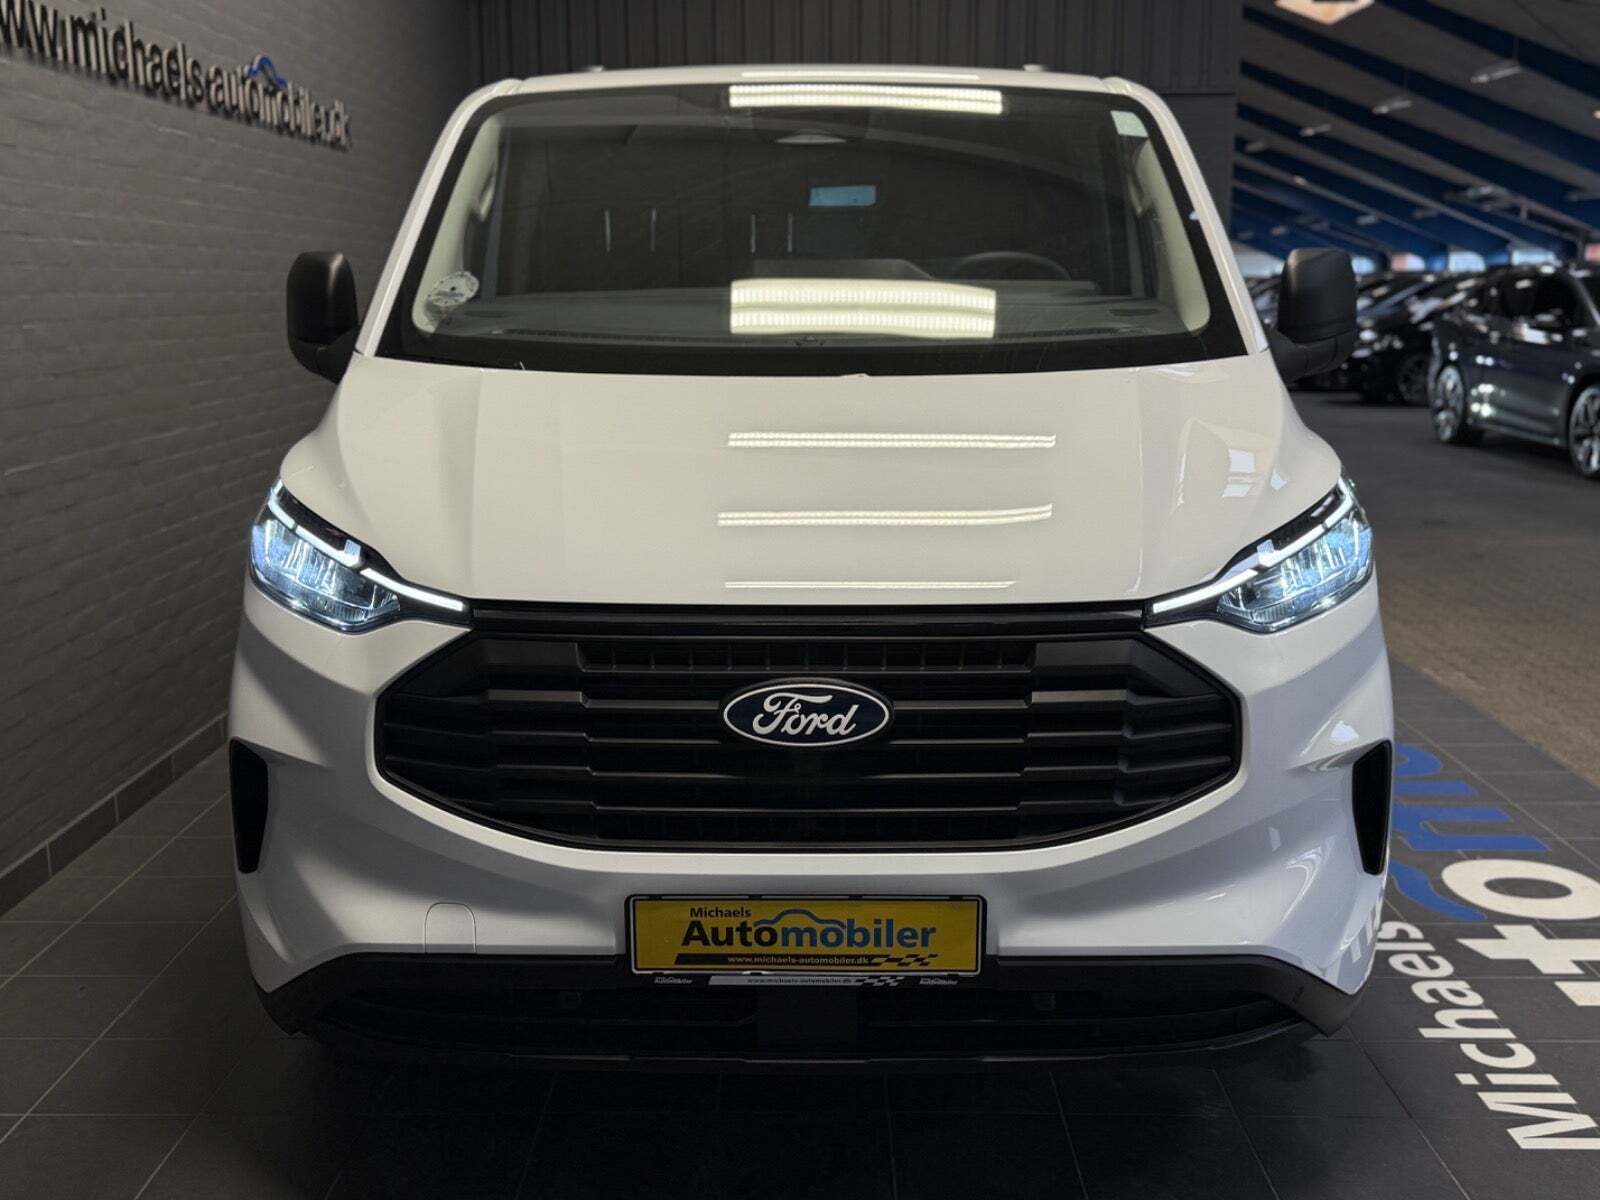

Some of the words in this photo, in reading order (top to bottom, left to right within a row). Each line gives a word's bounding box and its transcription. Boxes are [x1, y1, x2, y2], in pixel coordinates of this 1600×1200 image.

[752, 692, 860, 736] Ford
[690, 907, 752, 919] Michaels
[681, 918, 937, 948] Automobiler
[727, 954, 869, 967] www.michaels-automobiler.dk
[1377, 920, 1600, 1150] Michaels
